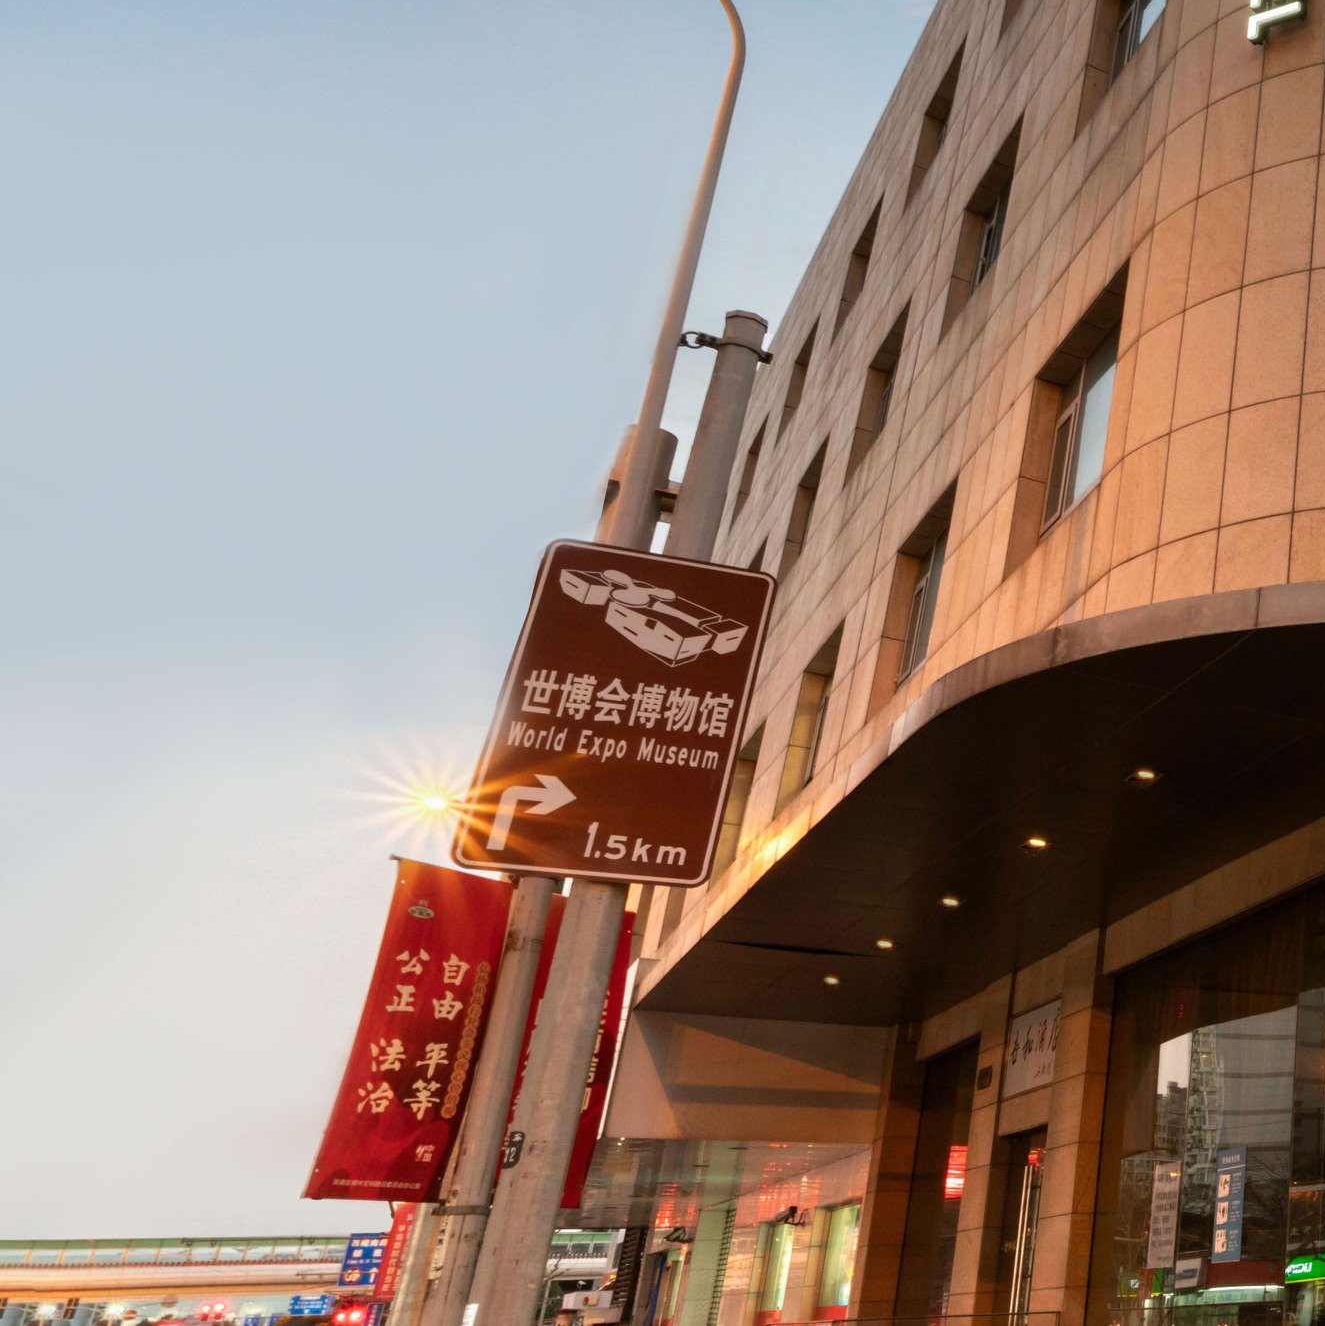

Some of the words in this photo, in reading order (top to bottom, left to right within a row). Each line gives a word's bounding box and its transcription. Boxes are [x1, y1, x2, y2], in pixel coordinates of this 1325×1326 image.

[521, 670, 734, 738] 世博会博物馆
[507, 721, 569, 751] World
[577, 730, 627, 763] Expo
[637, 738, 719, 769] Museum
[584, 821, 687, 865] 1.5km
